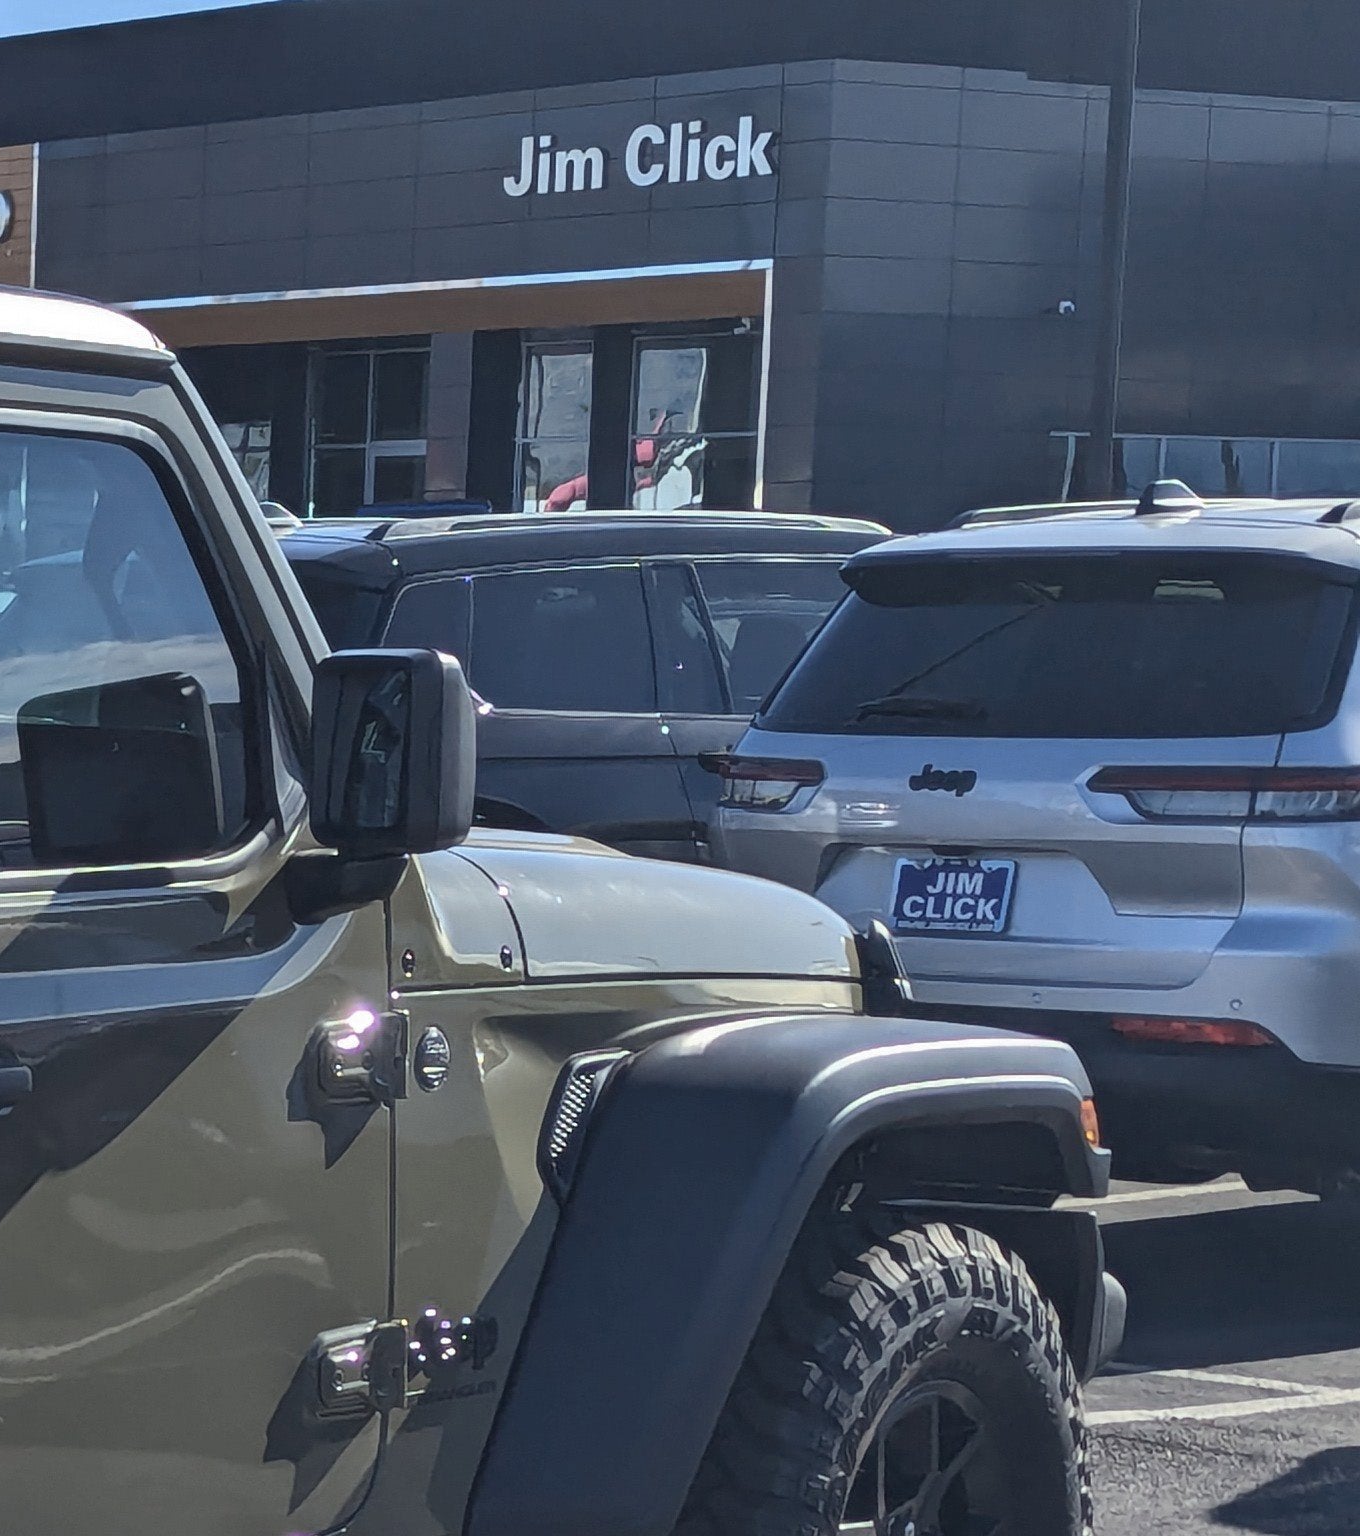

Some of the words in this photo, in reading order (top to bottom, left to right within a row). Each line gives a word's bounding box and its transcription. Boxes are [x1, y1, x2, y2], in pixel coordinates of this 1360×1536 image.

[503, 135, 604, 197] Jim
[625, 115, 773, 187] Click
[926, 872, 984, 896] JIM
[902, 895, 999, 921] CLICK
